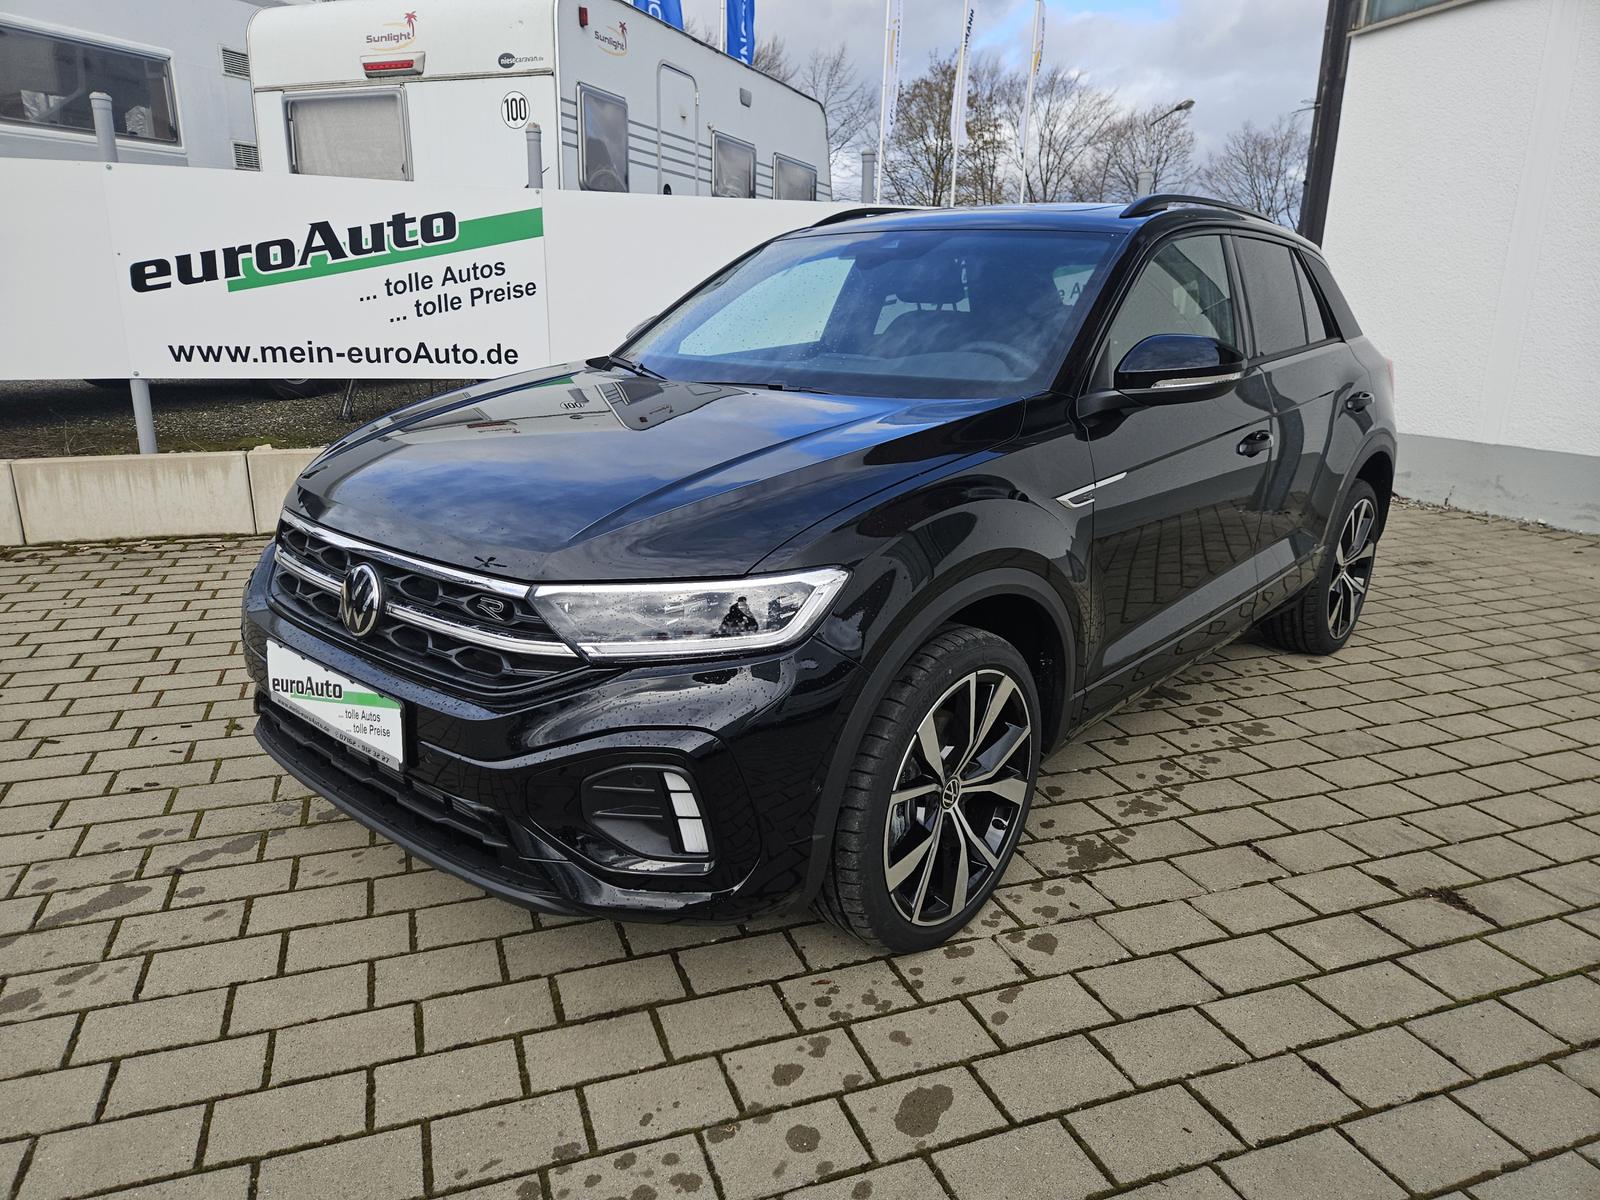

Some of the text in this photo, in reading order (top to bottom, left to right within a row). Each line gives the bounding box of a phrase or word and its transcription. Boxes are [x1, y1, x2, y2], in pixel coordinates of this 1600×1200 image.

[366, 32, 412, 43] Sunlight
[594, 30, 625, 51] Sunlight
[504, 97, 527, 121] 100
[130, 211, 457, 293] euroAuto
[384, 271, 433, 297] tolle
[441, 261, 506, 287] Autos
[414, 293, 462, 318] tolle
[470, 281, 537, 307] Preise
[168, 341, 519, 365] www.mein-euroAuto.de
[272, 676, 343, 699] euroAuto
[345, 709, 360, 720] tolle
[361, 709, 381, 722] Autos
[353, 723, 368, 735] tolle
[369, 724, 391, 737] Preise
